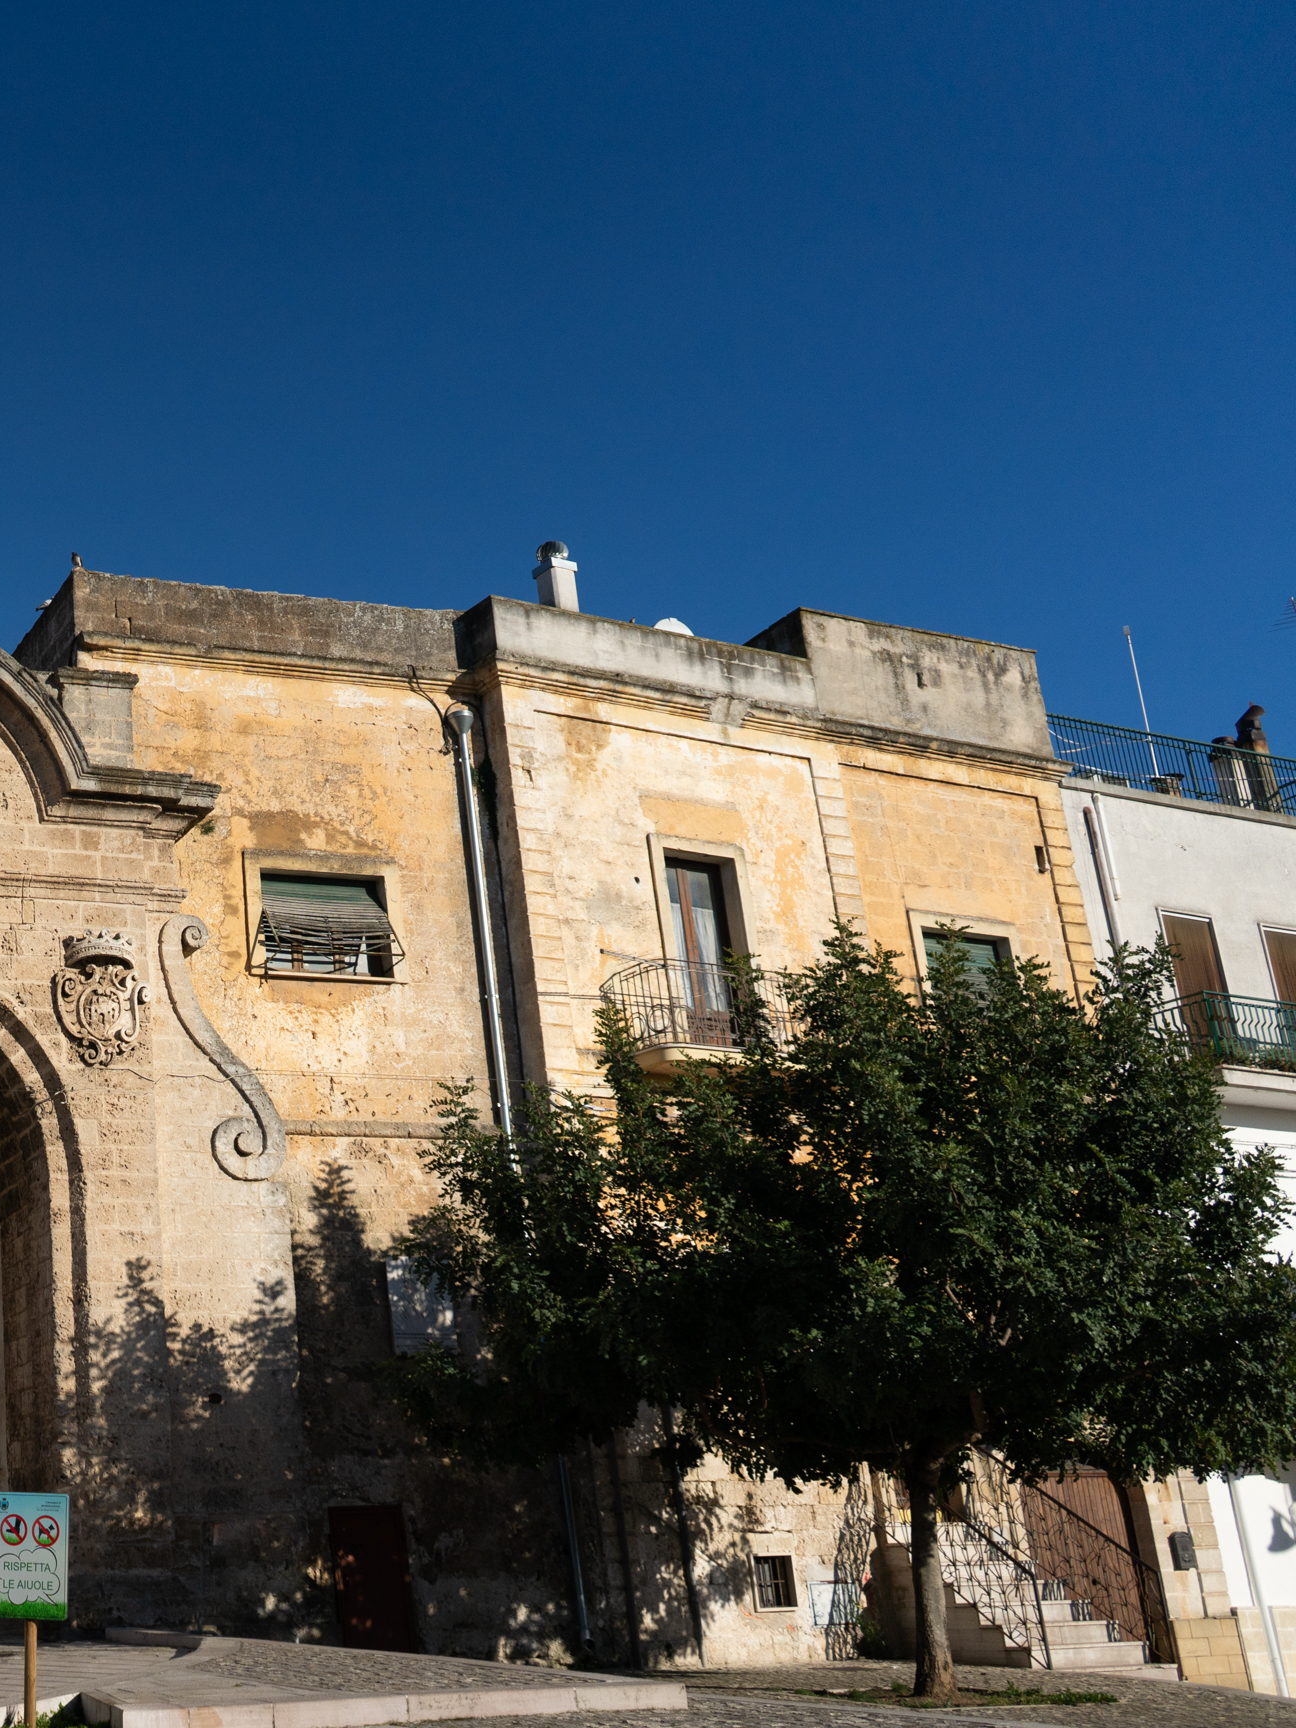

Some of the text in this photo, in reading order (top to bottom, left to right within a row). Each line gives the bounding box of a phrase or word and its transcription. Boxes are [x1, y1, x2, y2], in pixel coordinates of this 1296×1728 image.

[3, 1561, 51, 1572] RISPETTA
[2, 1579, 53, 1591] LE AIUOLE
